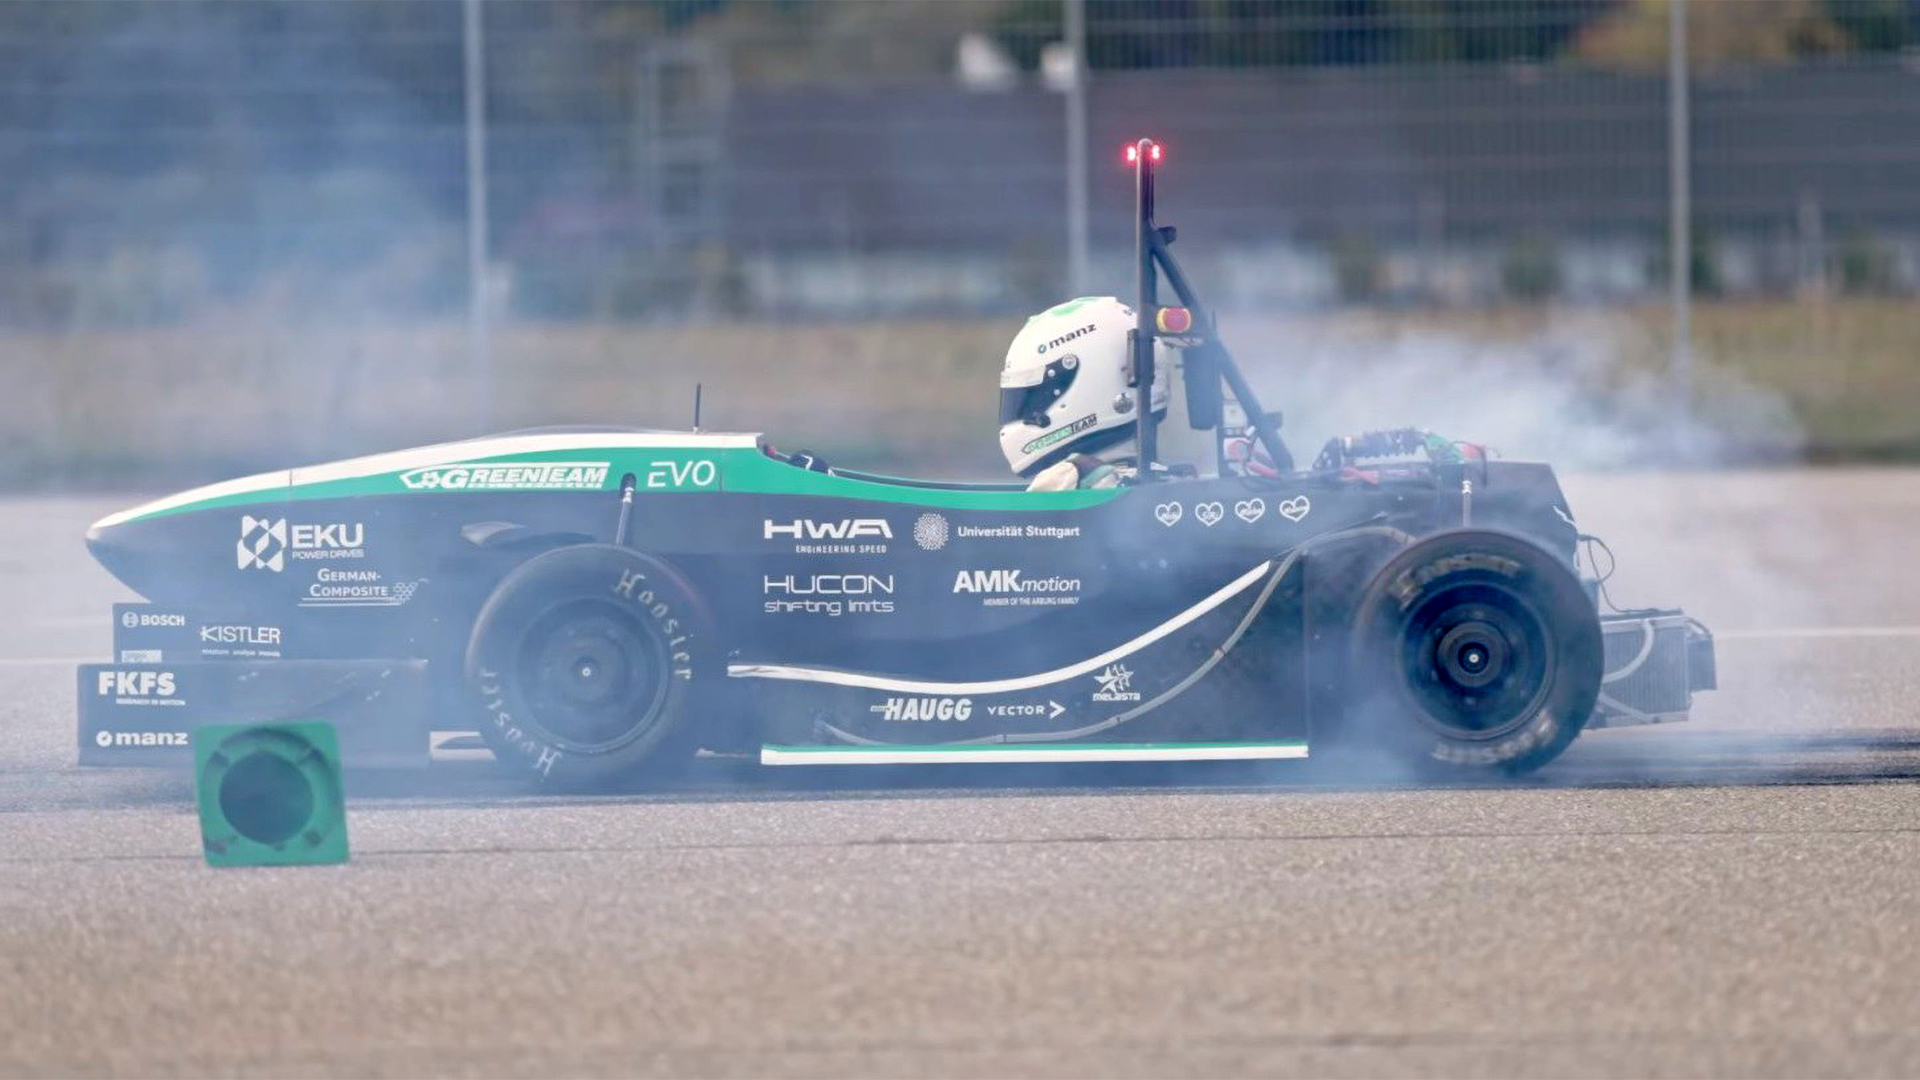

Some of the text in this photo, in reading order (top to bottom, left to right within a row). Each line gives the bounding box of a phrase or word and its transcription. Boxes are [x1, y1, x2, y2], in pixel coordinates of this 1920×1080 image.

[1048, 323, 1098, 349] manz
[438, 463, 609, 489] GREENTEAM
[647, 460, 715, 487] EVO
[291, 523, 364, 549] EKU
[764, 519, 893, 539] HWA
[957, 525, 1080, 539] Universität Stuttgart
[292, 550, 329, 559] POWER
[795, 545, 887, 553] ENGINEERING SPEED
[764, 575, 894, 594] HUCON
[140, 614, 185, 627] BOSCH
[611, 568, 694, 681] Hoosier
[200, 626, 281, 645] KISTLER
[98, 671, 177, 696] FKFS
[884, 698, 973, 721] HAUGG
[987, 705, 1046, 716] VECTOR
[115, 732, 189, 746] manz
